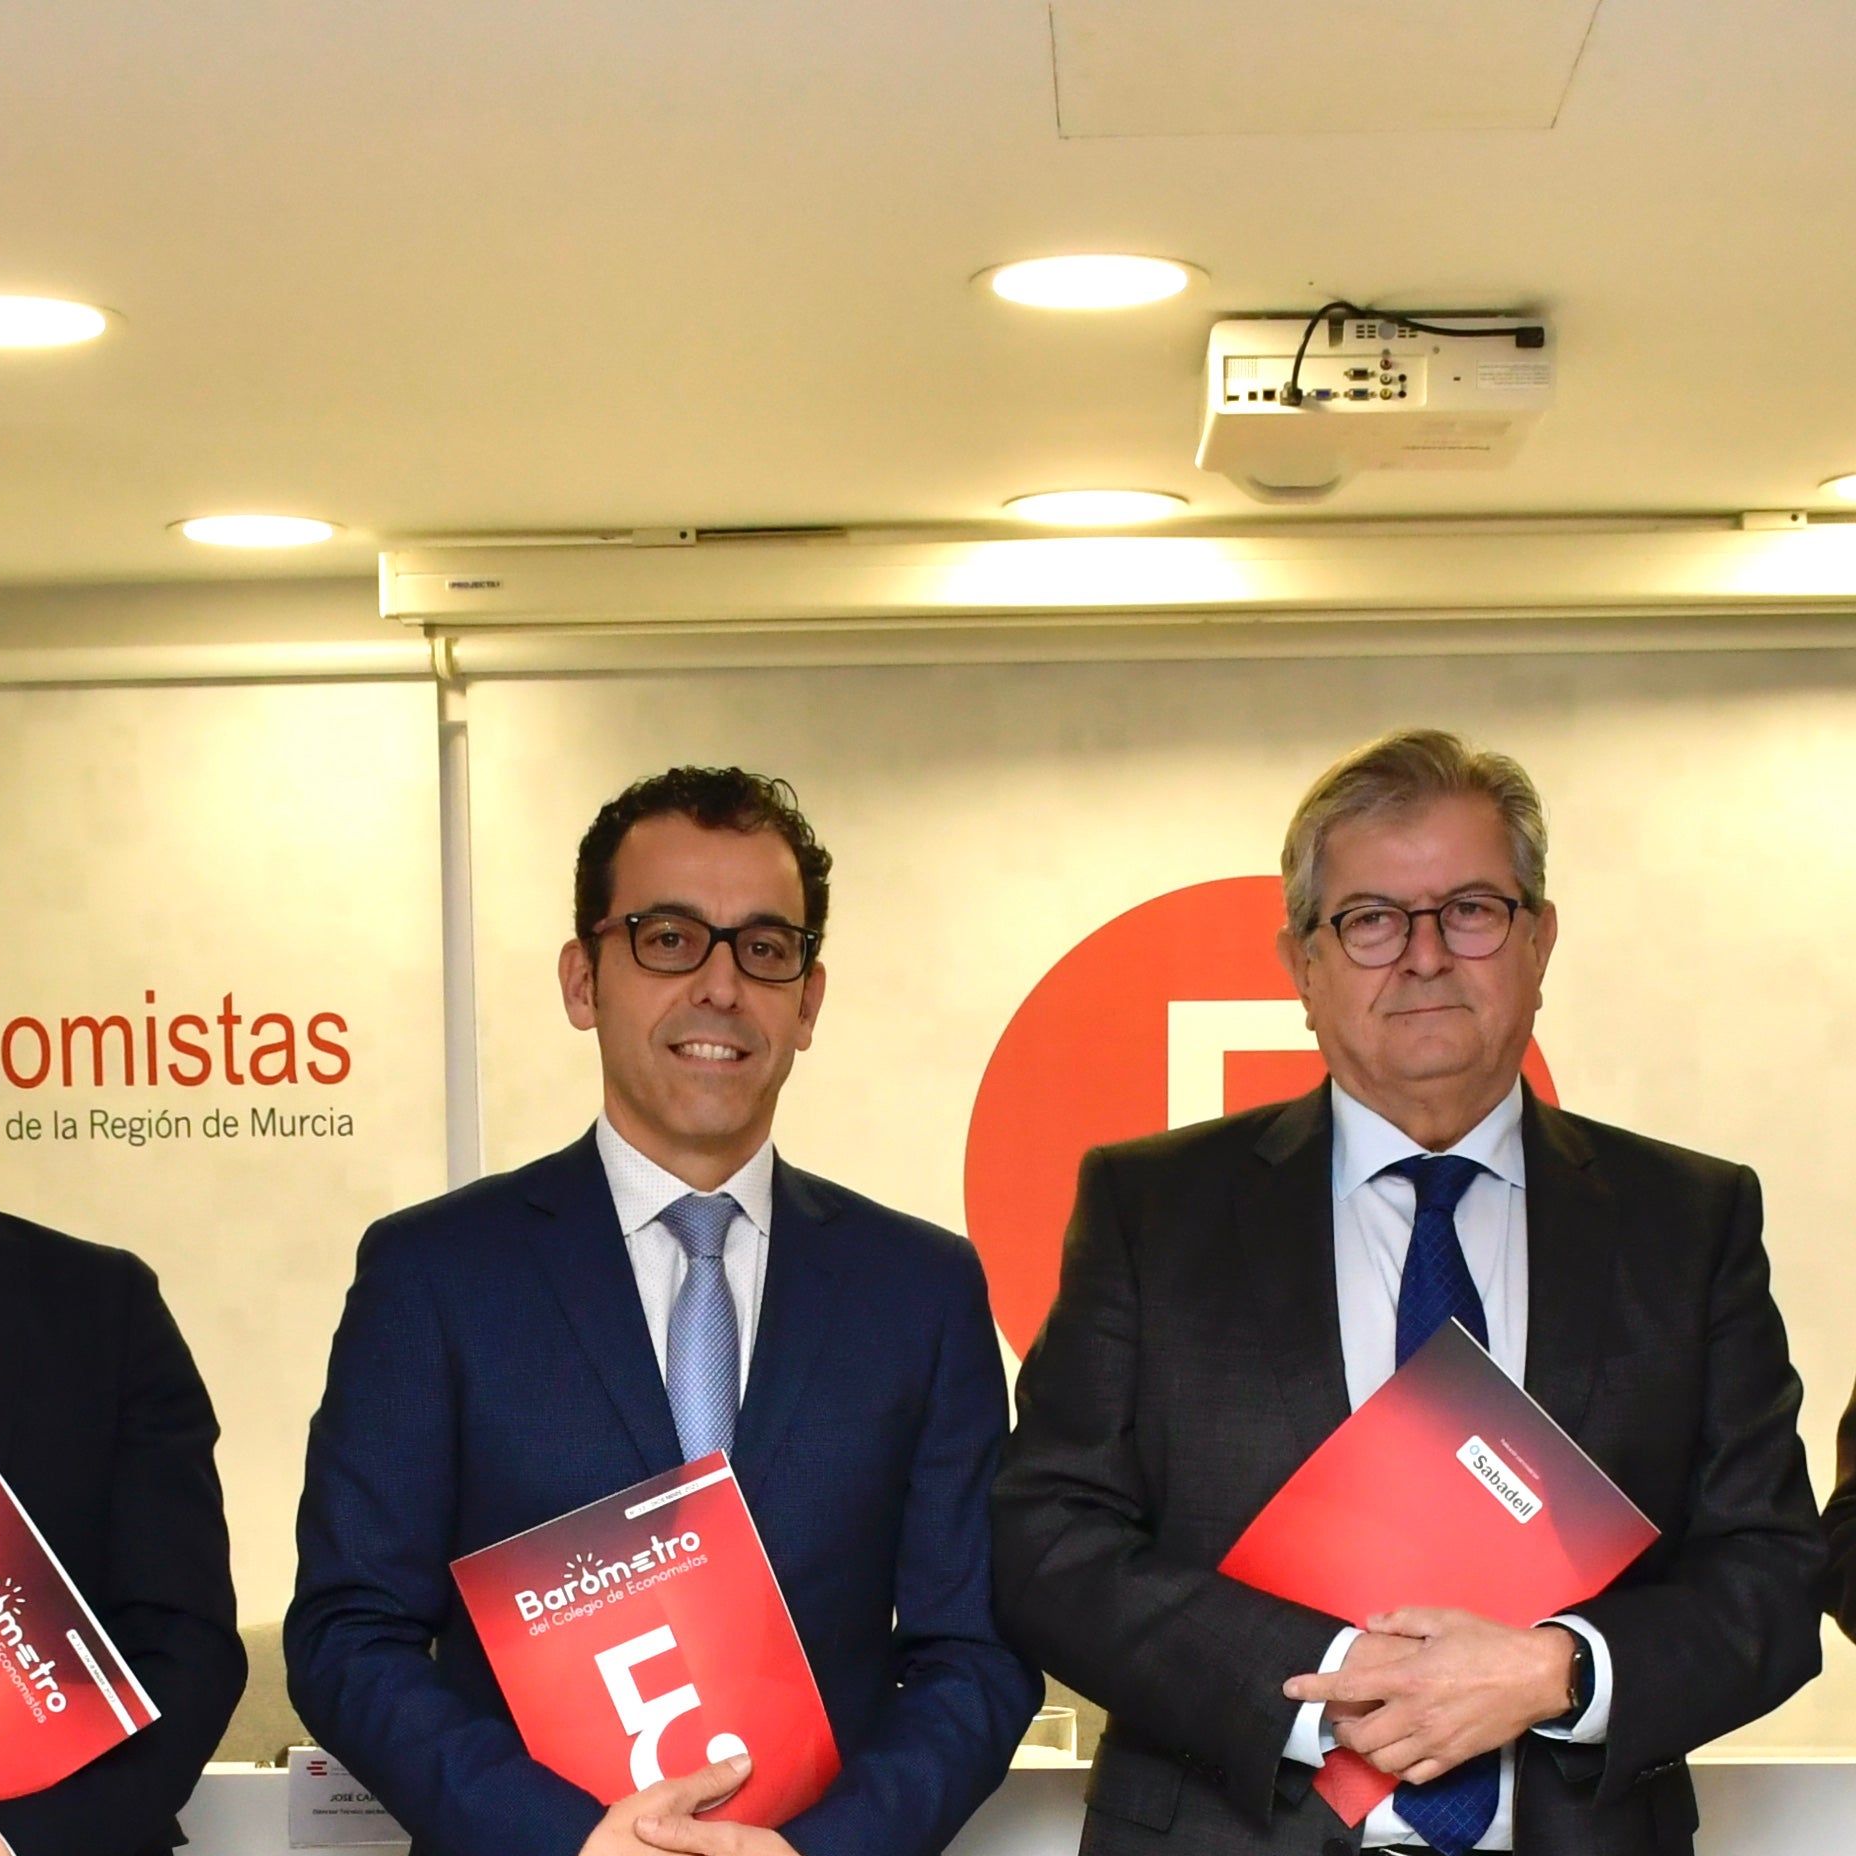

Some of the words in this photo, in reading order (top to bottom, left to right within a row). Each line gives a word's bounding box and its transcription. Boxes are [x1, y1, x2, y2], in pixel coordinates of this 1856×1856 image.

[0, 989, 352, 1089] omistas
[5, 1110, 42, 1140] de
[53, 1110, 78, 1140] la
[90, 1109, 191, 1147] Región
[202, 1108, 239, 1138] de
[250, 1107, 355, 1138] Murcia
[1473, 1454, 1533, 1516] Sabadell
[529, 1618, 550, 1637] del
[551, 1597, 604, 1626] Colegio
[606, 1587, 624, 1605] de
[626, 1552, 708, 1595] Economistas
